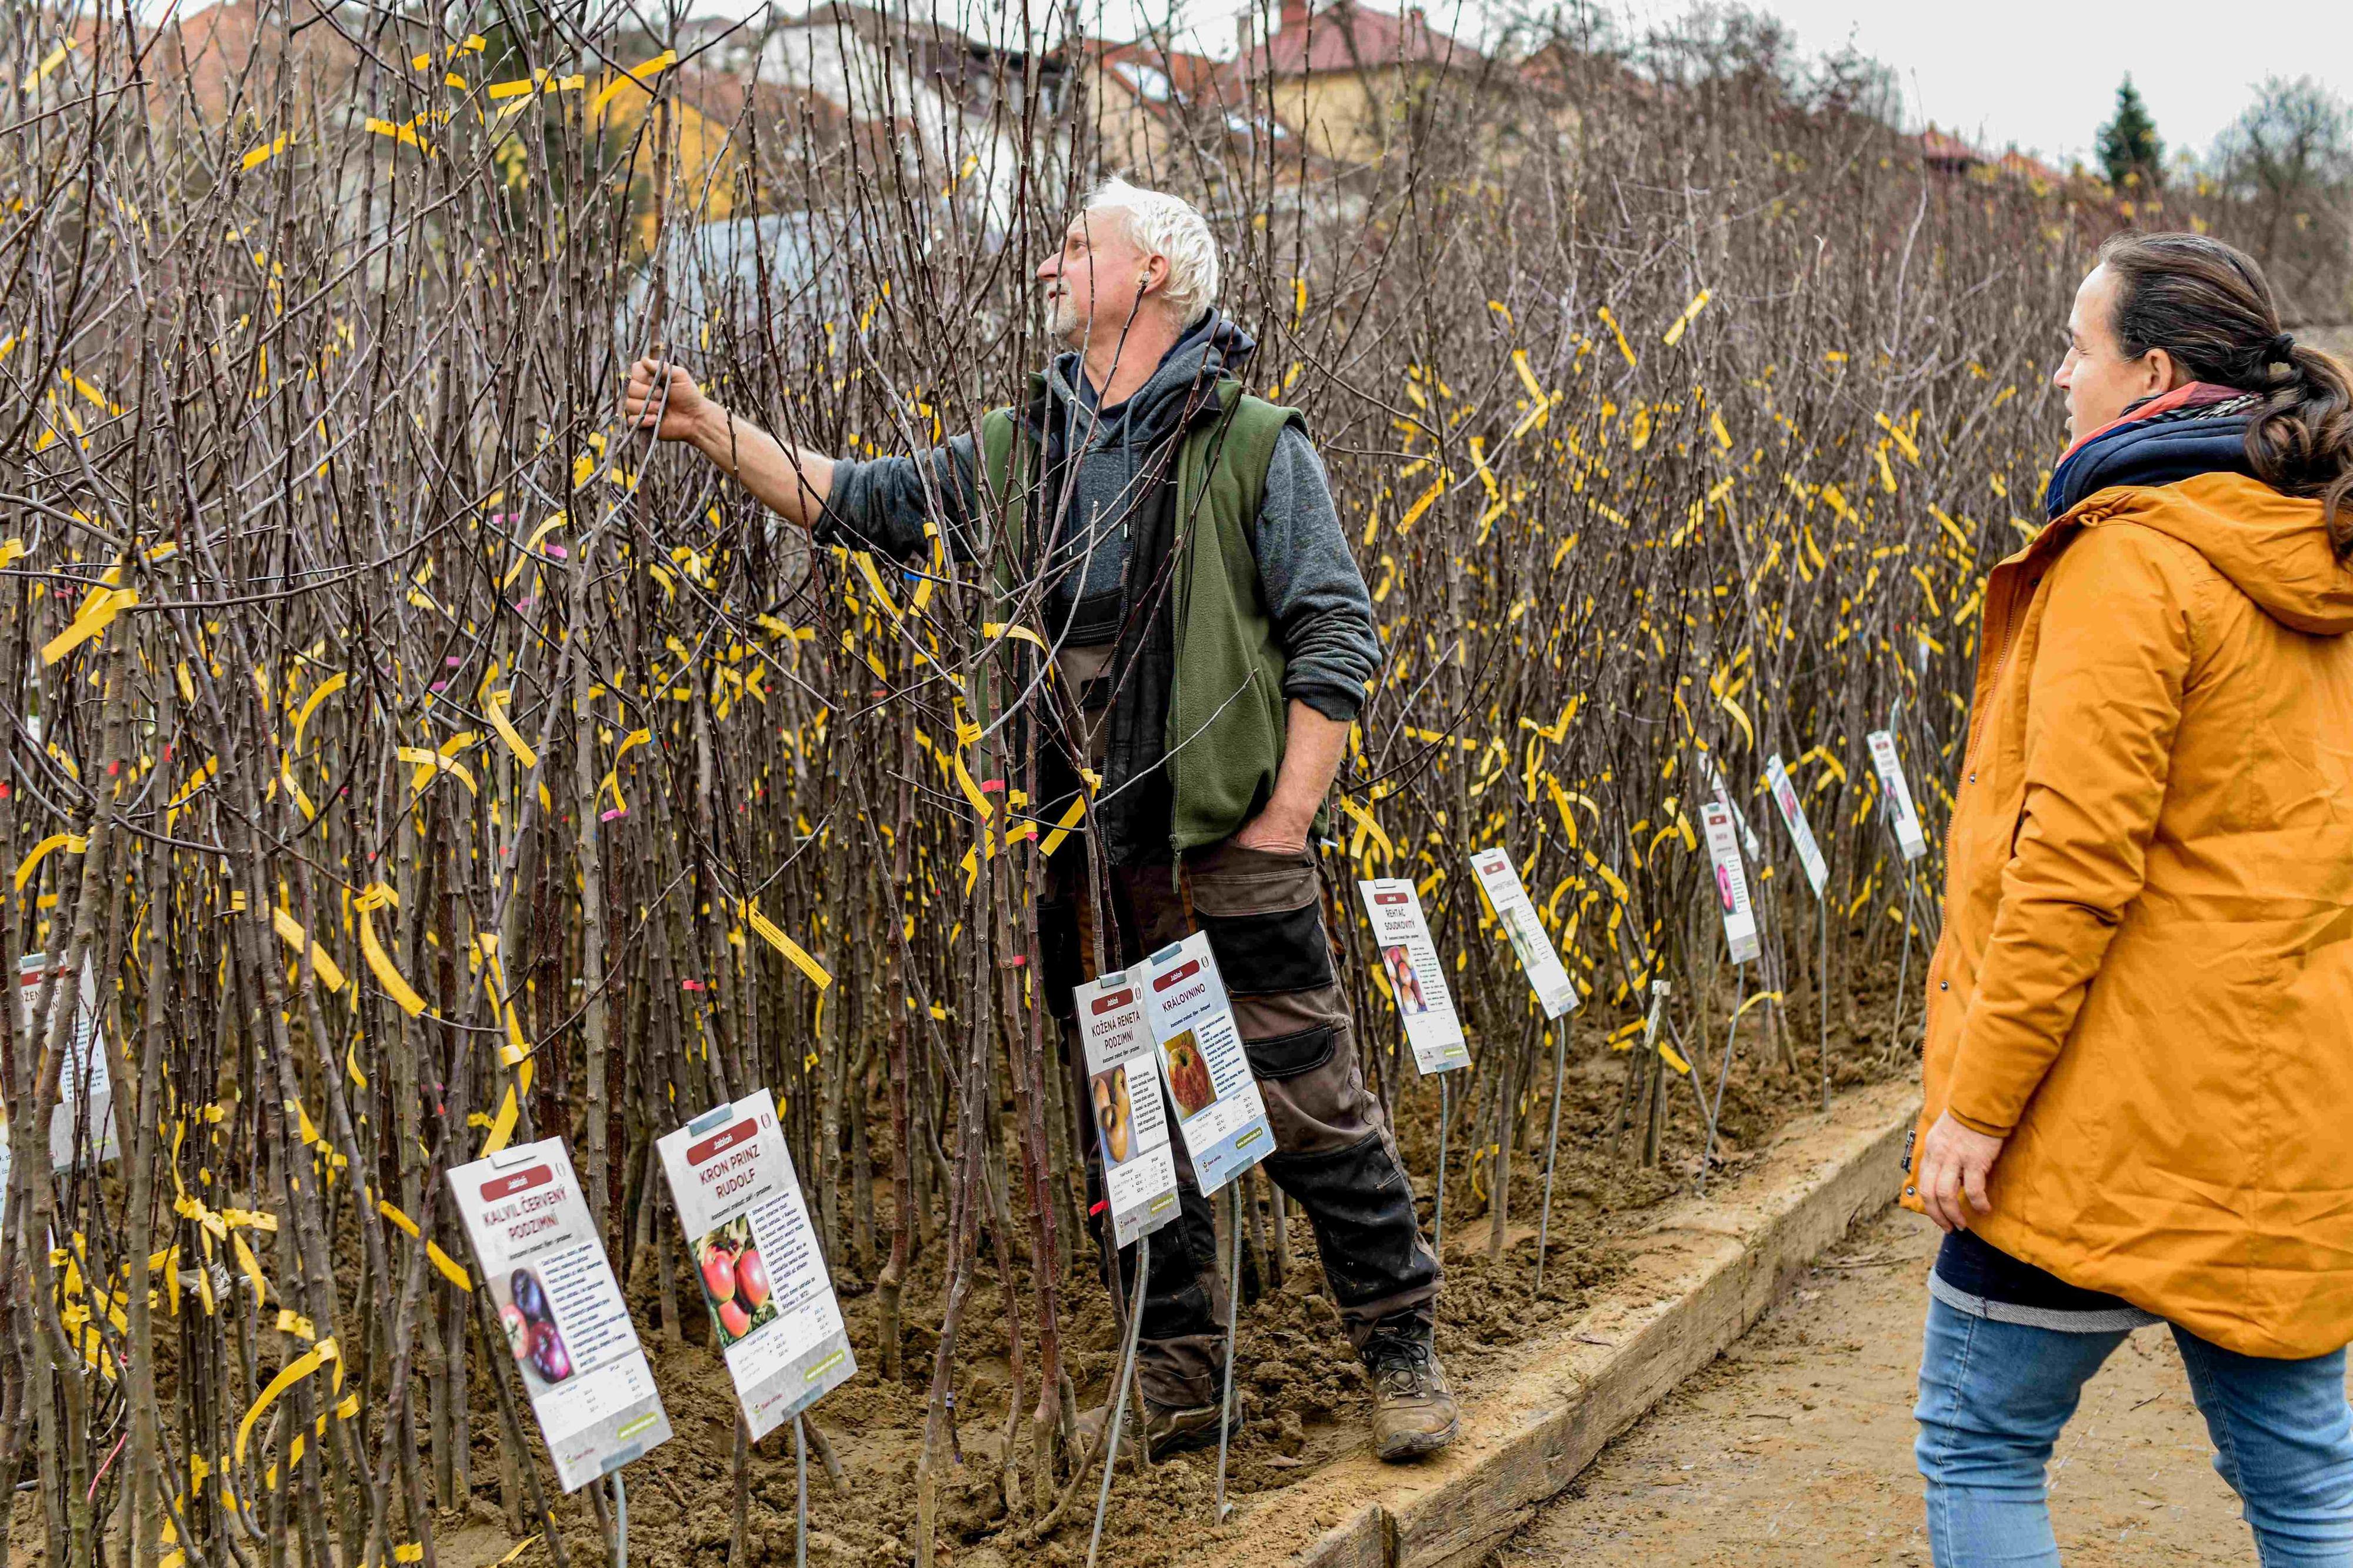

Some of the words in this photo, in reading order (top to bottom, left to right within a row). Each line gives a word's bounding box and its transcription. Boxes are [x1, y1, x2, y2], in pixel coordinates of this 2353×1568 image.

[1171, 970, 1182, 981] Jabloň
[1107, 996, 1118, 1006] Jabloň
[1162, 983, 1205, 1012] KRÁLOVNINO
[1091, 1016, 1116, 1037] KOŽENÁ
[1117, 1010, 1140, 1027] RENETA
[1104, 1027, 1133, 1049] PODZIMNÍ
[699, 1160, 729, 1184] KRON
[730, 1144, 759, 1169] PRINZ
[716, 1168, 754, 1198] RUDOLF
[482, 1204, 521, 1226] KALVIL
[521, 1186, 565, 1213] ČERVENÝ
[509, 1210, 558, 1238] PODZIMNÍ
